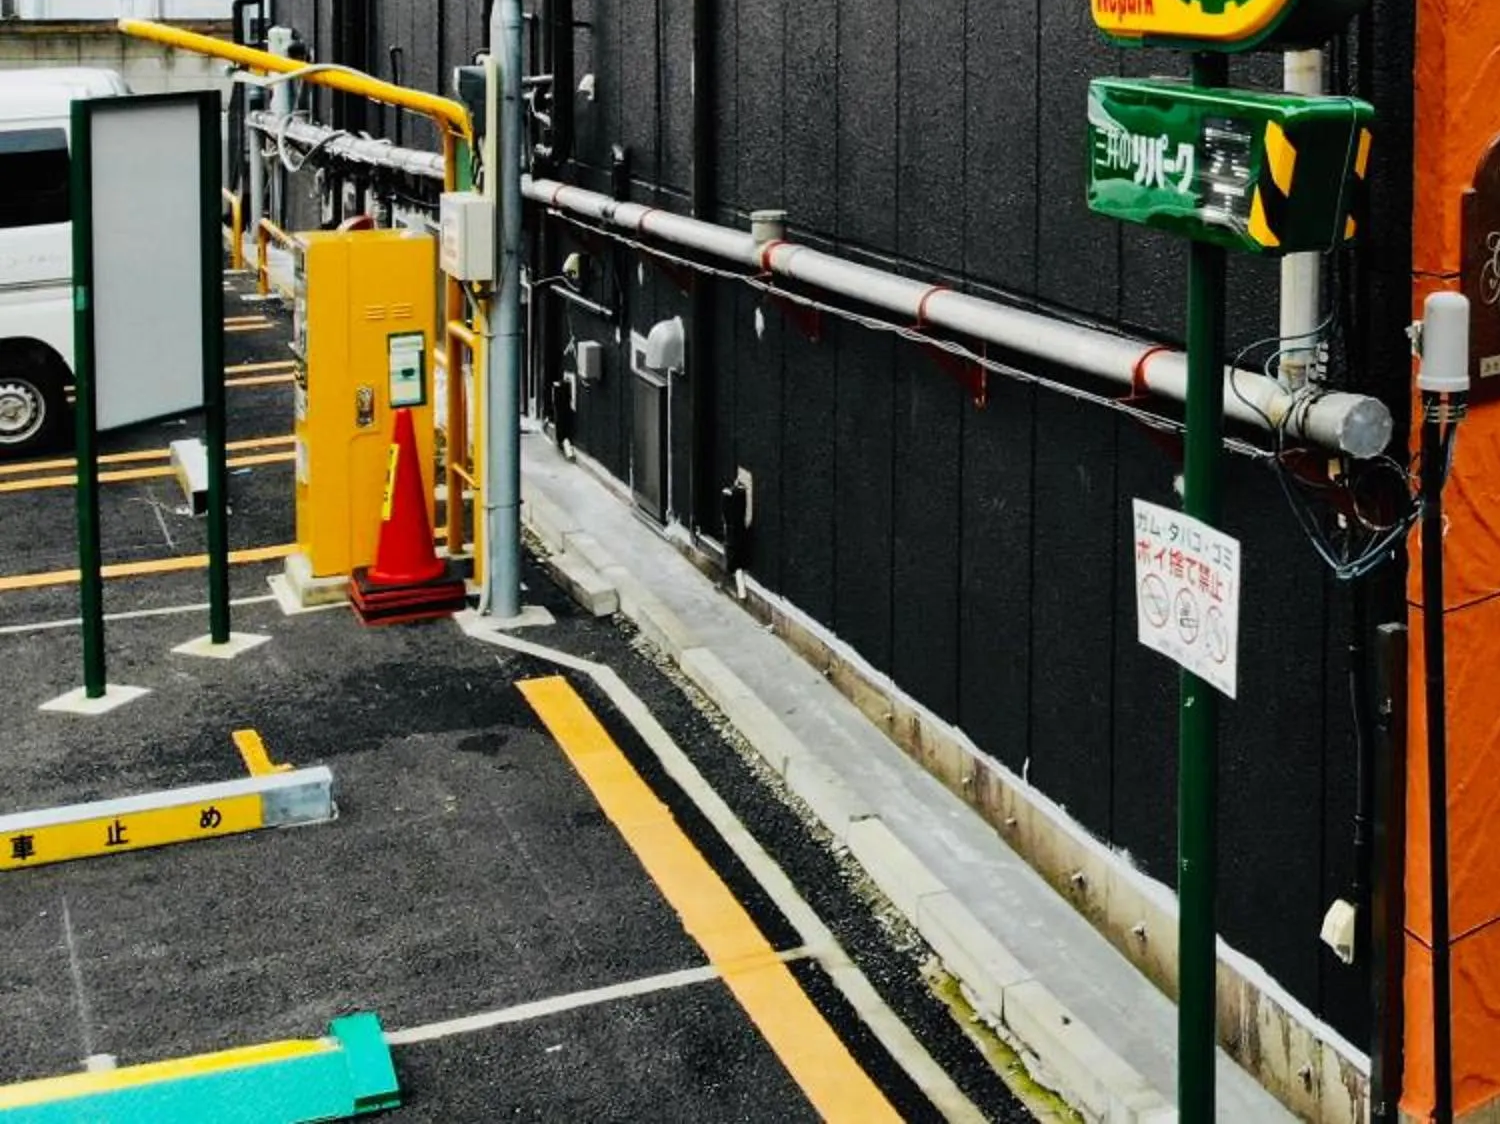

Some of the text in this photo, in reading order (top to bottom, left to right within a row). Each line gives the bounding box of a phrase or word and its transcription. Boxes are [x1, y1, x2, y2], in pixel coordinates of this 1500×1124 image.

[1095, 127, 1195, 194] 三井のリパーク
[10, 806, 222, 860] 車止め
